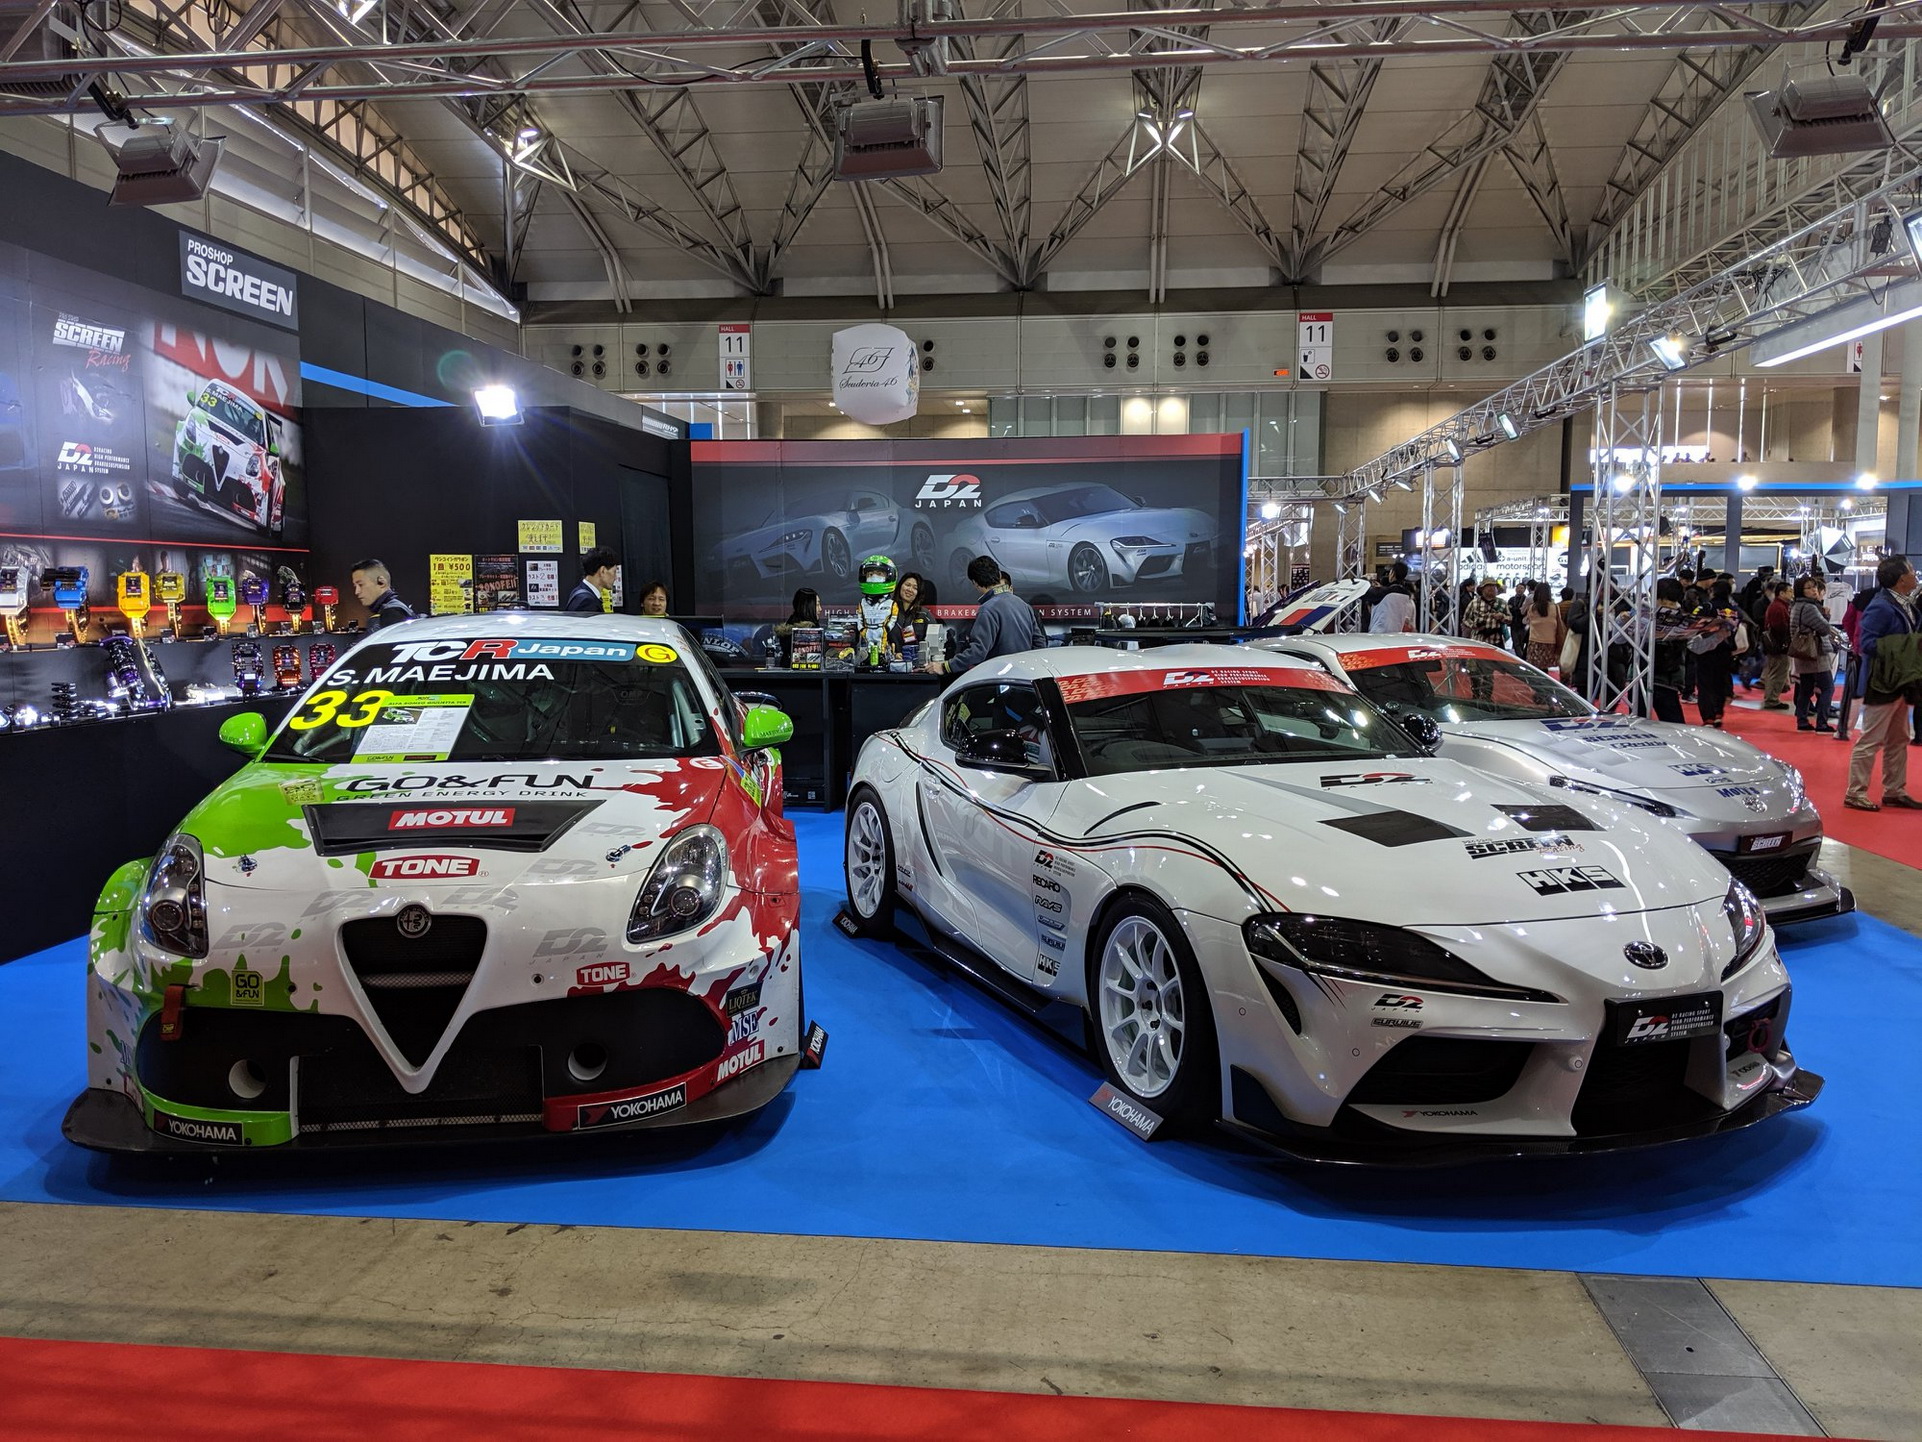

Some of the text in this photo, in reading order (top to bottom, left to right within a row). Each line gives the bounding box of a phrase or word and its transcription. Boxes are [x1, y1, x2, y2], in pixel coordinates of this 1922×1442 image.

[187, 239, 233, 265] PROSHOP
[186, 255, 293, 316] SCREEN
[54, 321, 123, 353] SCREEN
[1306, 325, 1325, 342] 11
[725, 336, 743, 353] 11
[85, 349, 131, 372] Racing
[200, 393, 218, 407] 33
[58, 442, 93, 465] D2
[57, 463, 94, 473] JAPAN
[915, 474, 981, 499] D2
[915, 500, 982, 508] JAPAN
[449, 563, 470, 571] ¥500
[1050, 608, 1092, 616] SYSTEM
[390, 640, 627, 664] TCR Japan
[1163, 671, 1214, 686] D2
[289, 690, 396, 731] 33
[346, 774, 594, 792] GO&FUN
[336, 790, 588, 801] GREEN ENERGY DRINK
[394, 809, 509, 828] MOTUL
[381, 858, 474, 877] TONE
[1034, 849, 1054, 868] D2
[1033, 874, 1060, 893] RECARO
[1517, 865, 1624, 895] HKS
[1035, 895, 1062, 913] RAYS
[532, 927, 609, 957] D2
[234, 973, 260, 989] GO
[581, 964, 628, 984] TONE
[235, 989, 260, 1000] &FUN
[1373, 993, 1424, 1009] D2
[731, 1011, 760, 1041] MSE
[1626, 1016, 1670, 1039] D2
[1625, 1034, 1667, 1045] JAPAN
[716, 1044, 762, 1081] MOTUL
[610, 1089, 684, 1119] YOKOHAMA
[1107, 1095, 1156, 1134] YOKOHAMA
[168, 1120, 238, 1141] YOKOHAMA
